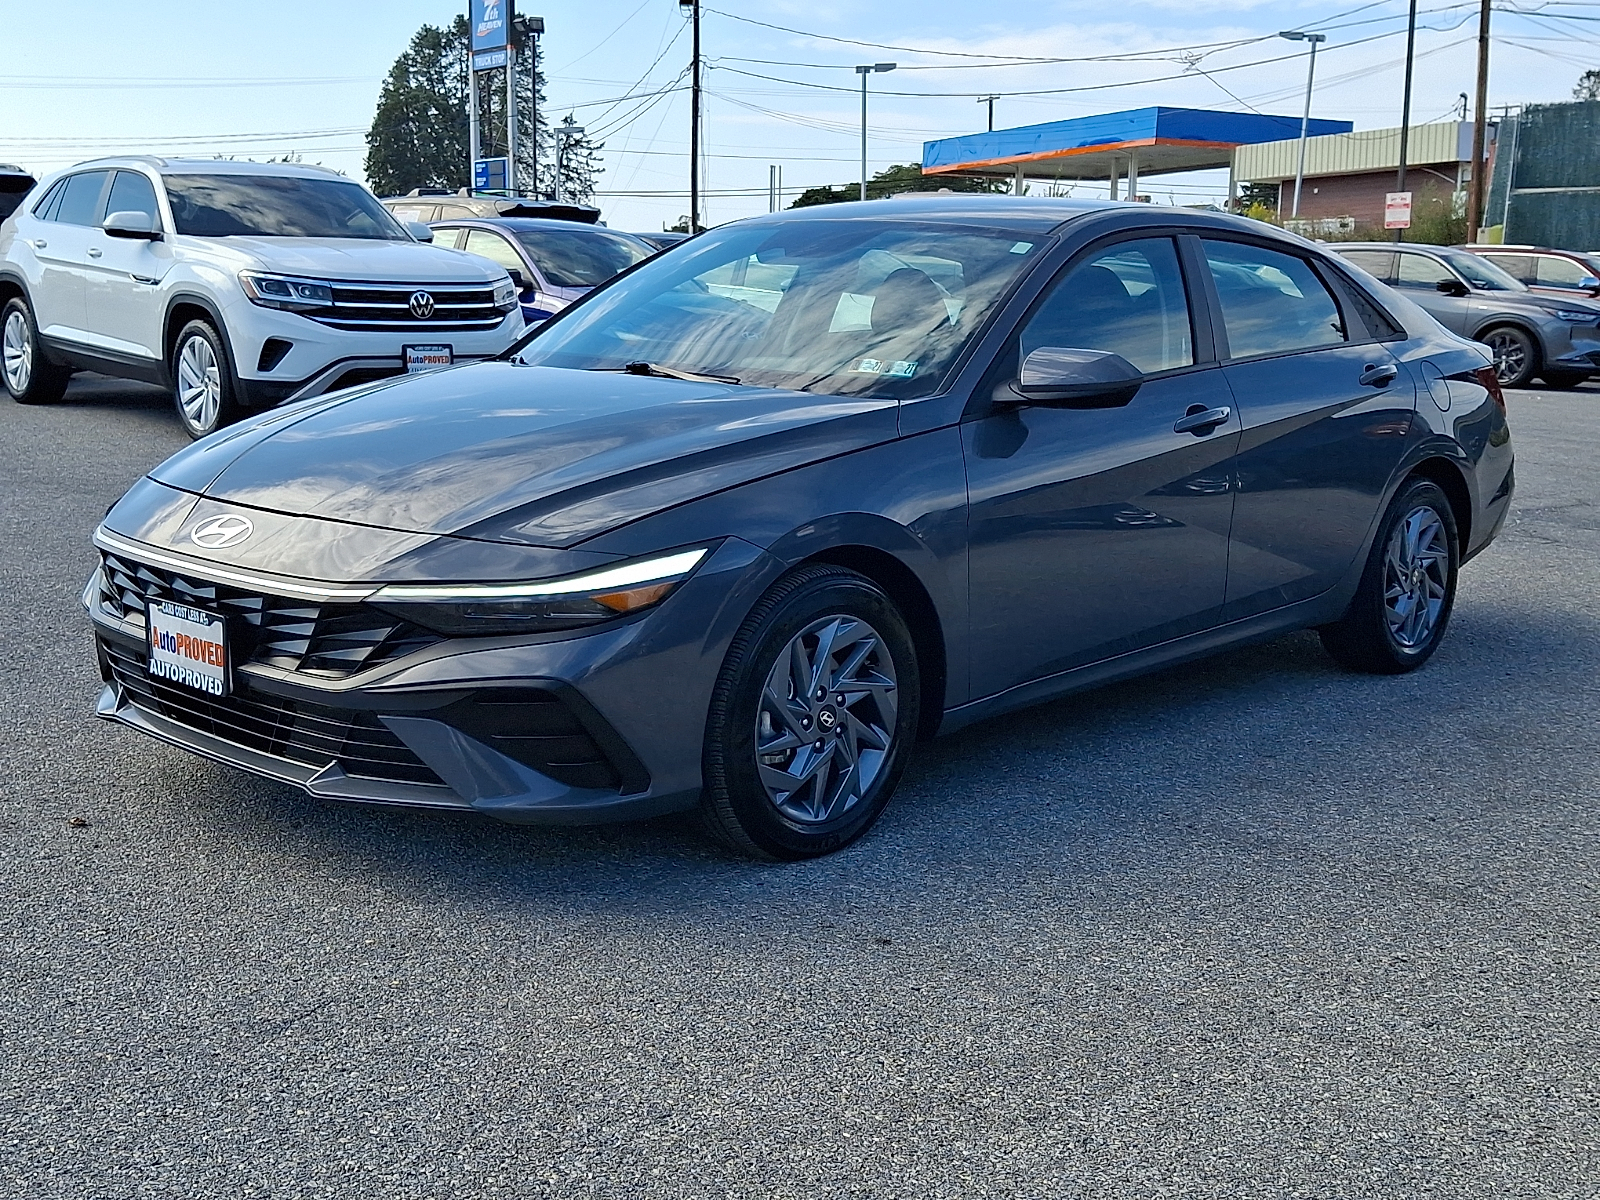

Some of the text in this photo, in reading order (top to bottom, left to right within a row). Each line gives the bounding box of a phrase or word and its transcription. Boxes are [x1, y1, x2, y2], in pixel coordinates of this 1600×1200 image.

[483, 0, 499, 21] 7th
[478, 20, 502, 32] HEAVEN
[475, 53, 505, 67] TRUCK STOP
[408, 356, 449, 364] AutoPROVED
[162, 602, 174, 615] CARS
[175, 605, 187, 618] COST
[188, 609, 199, 622] LESS
[153, 626, 225, 667] AutoPROVED
[149, 659, 222, 695] AUTOPROVED
